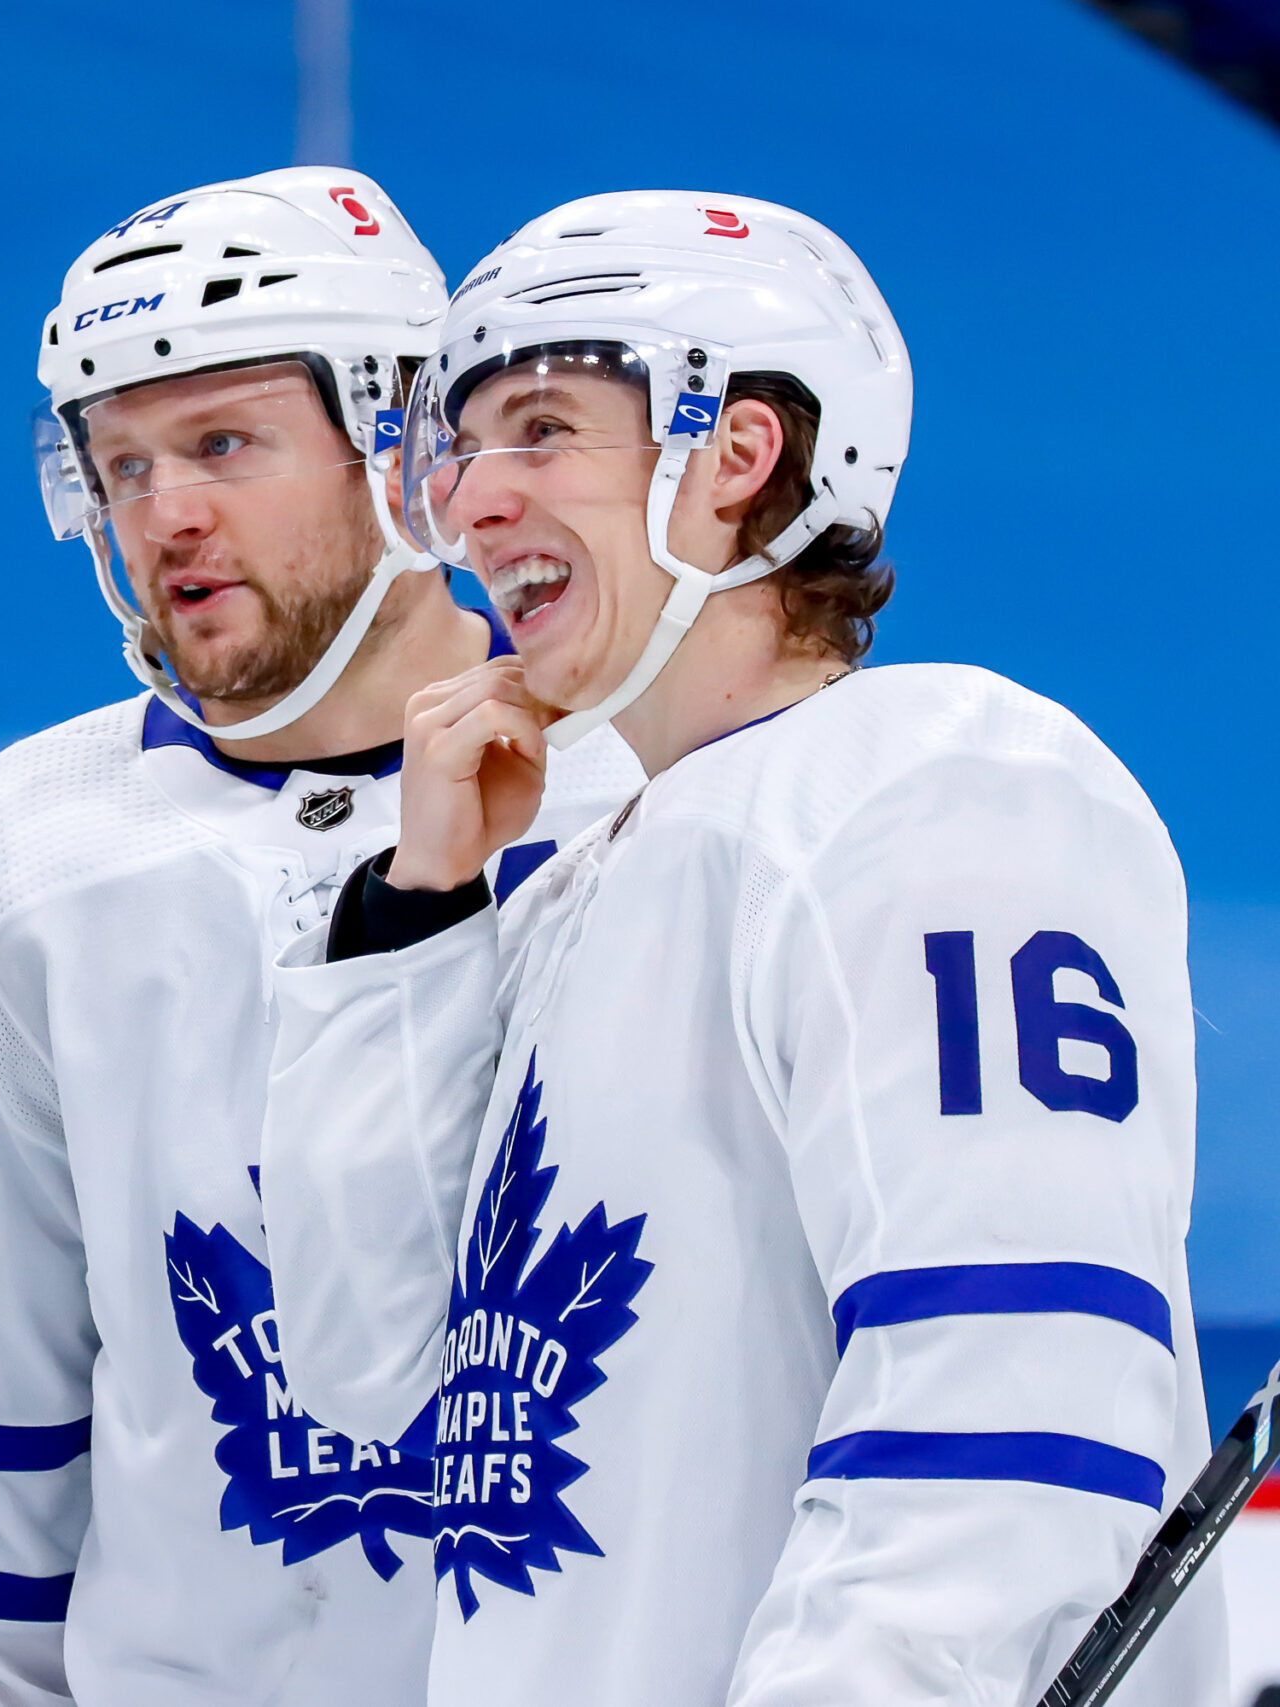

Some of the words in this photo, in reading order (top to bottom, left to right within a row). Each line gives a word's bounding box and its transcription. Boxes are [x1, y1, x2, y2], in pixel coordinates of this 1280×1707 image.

[74, 293, 166, 331] CCM
[309, 798, 344, 824] NHL
[924, 930, 1138, 1123] 16
[434, 1454, 532, 1507] LEAFS
[1173, 1530, 1216, 1587] TRUE
